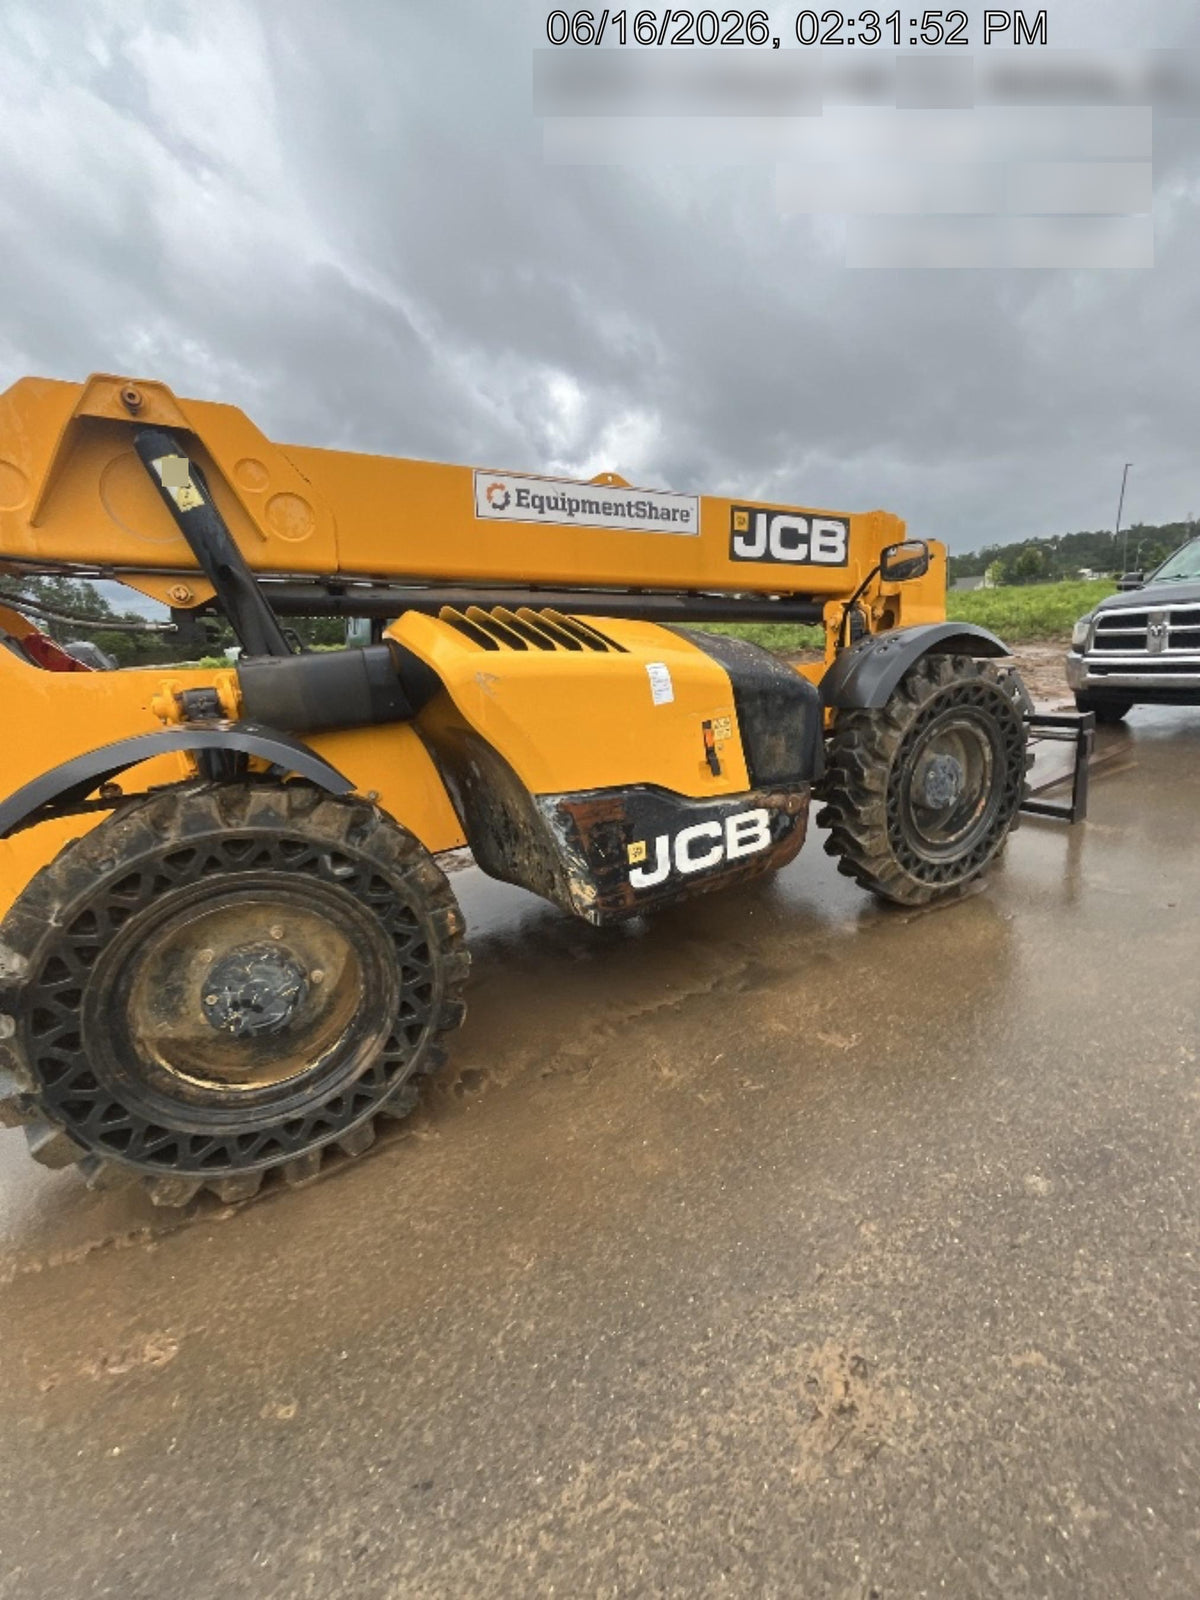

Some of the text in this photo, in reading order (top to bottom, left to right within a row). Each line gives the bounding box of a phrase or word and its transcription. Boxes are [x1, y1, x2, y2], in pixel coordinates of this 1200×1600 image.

[515, 488, 691, 523] EquipmentShare
[733, 512, 847, 563] JCB
[628, 808, 772, 889] JCB
